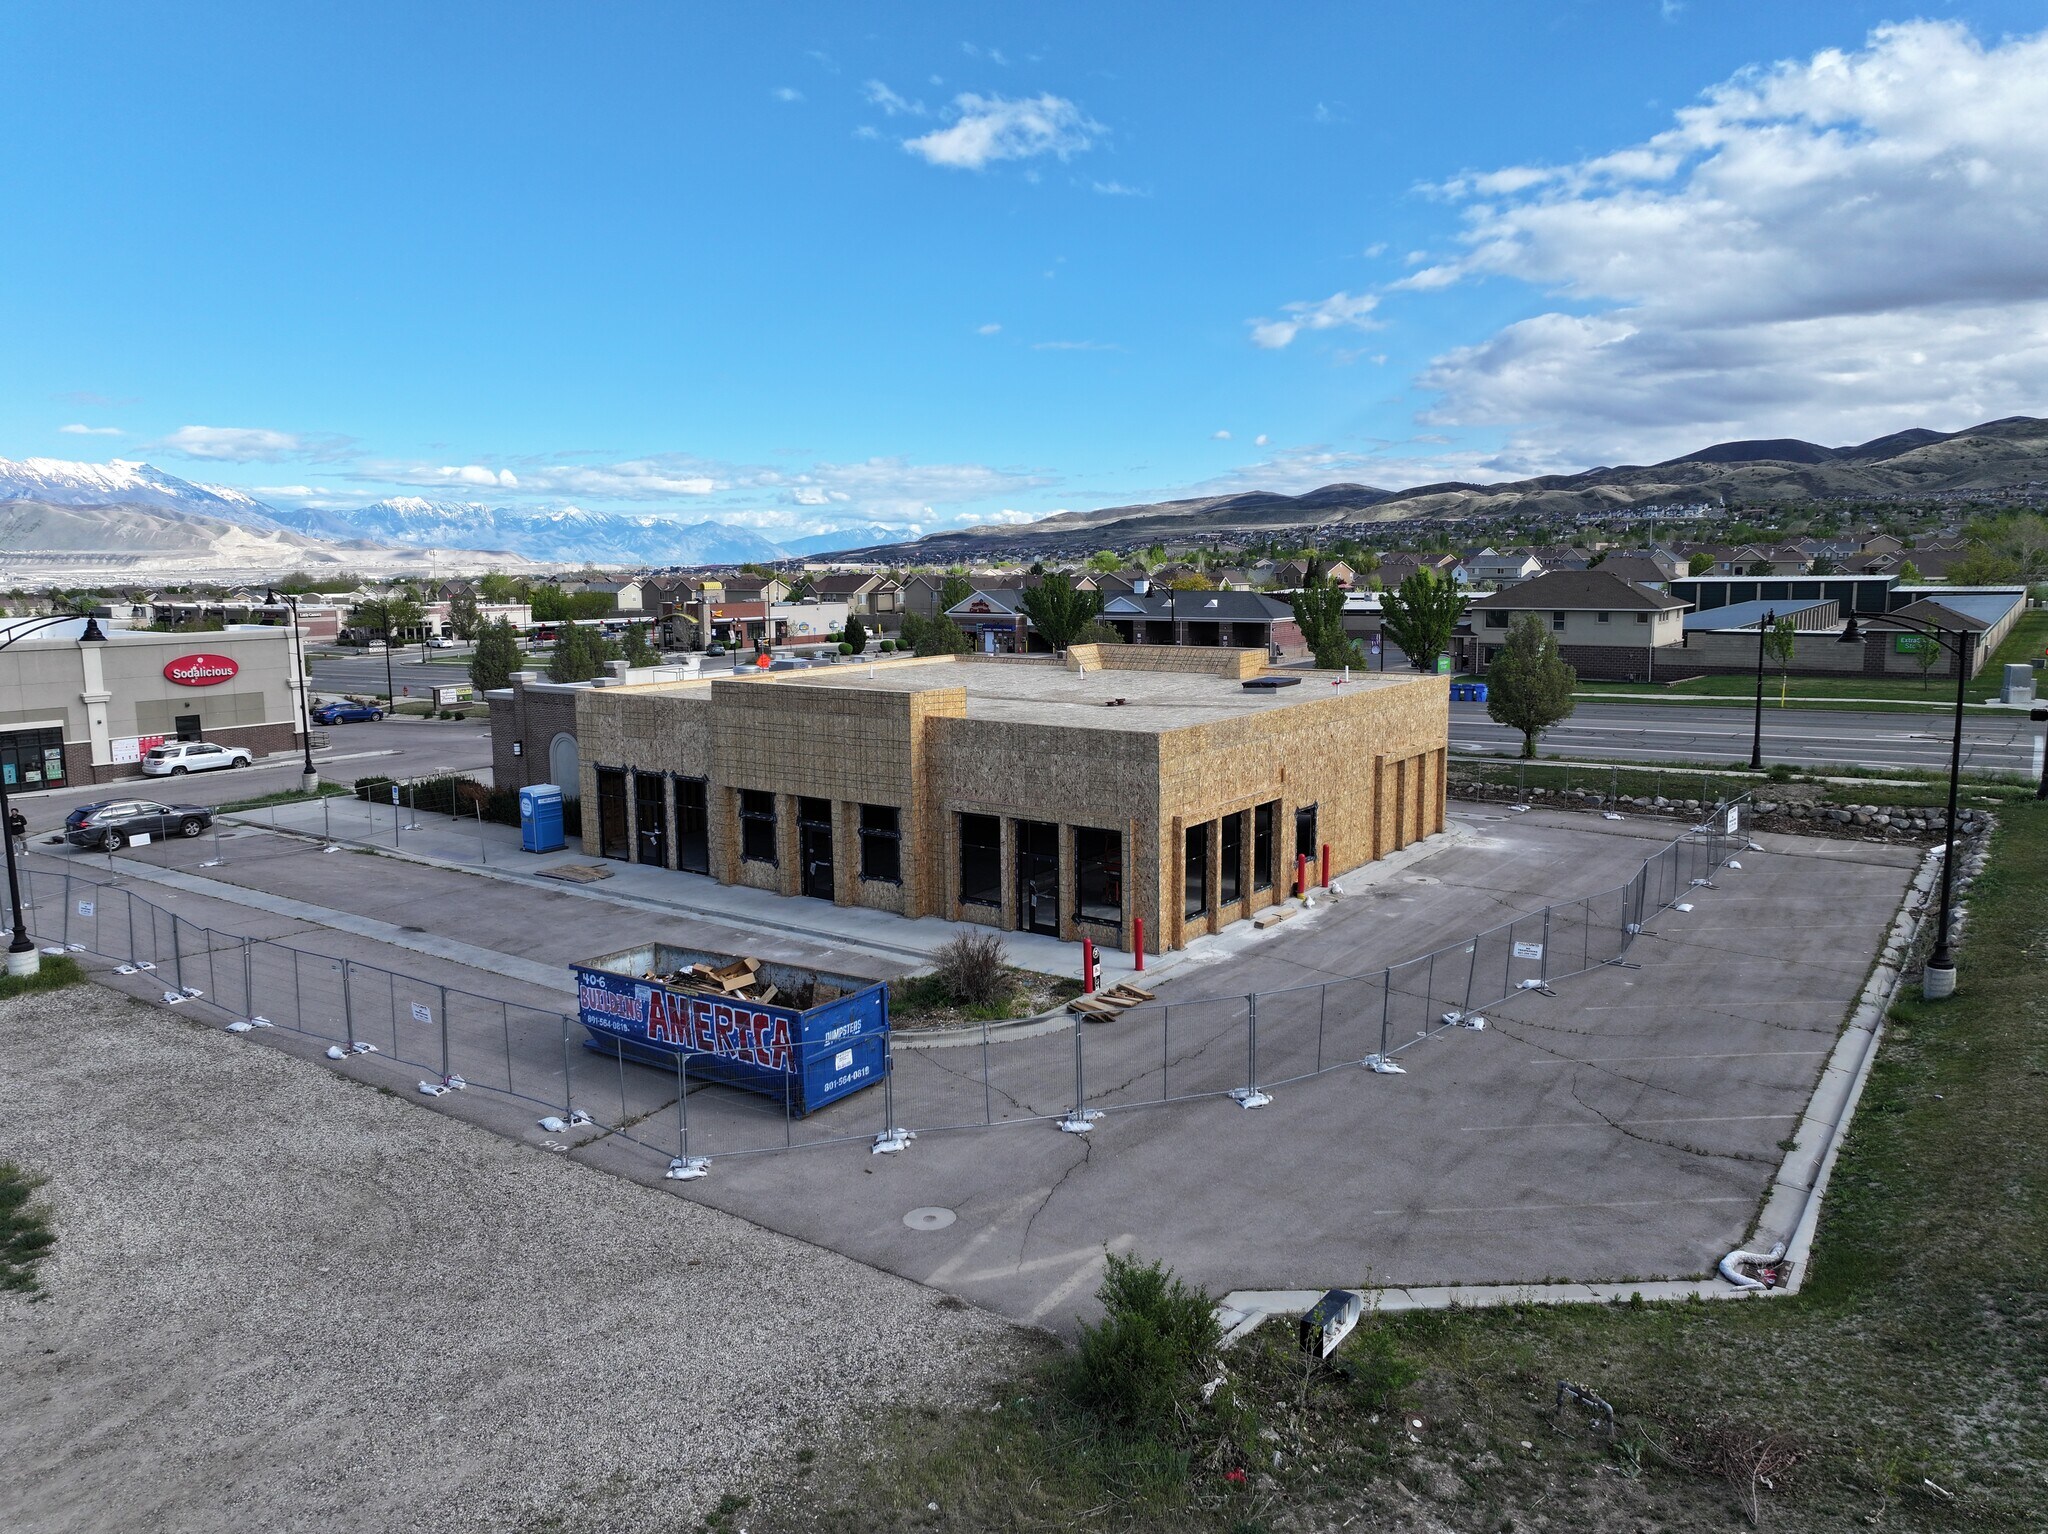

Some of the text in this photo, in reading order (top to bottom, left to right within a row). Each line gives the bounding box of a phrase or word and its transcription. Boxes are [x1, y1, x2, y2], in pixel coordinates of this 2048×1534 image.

[173, 666, 233, 678] Sodalicious
[582, 972, 606, 988] 40-6
[580, 985, 643, 1022] BUILDING
[648, 989, 798, 1075] AMERICA
[825, 1019, 862, 1042] DUMPSTERS
